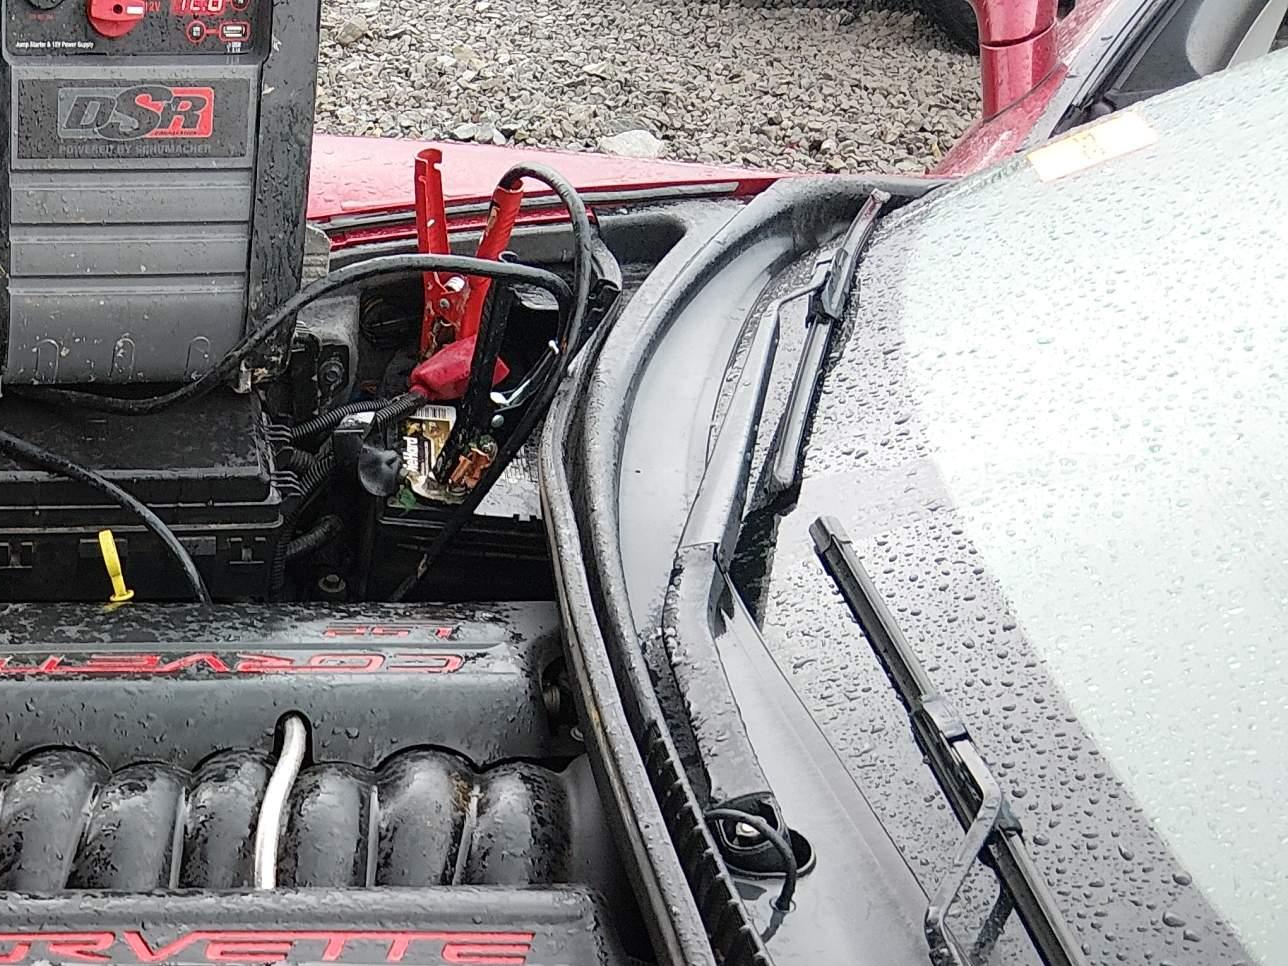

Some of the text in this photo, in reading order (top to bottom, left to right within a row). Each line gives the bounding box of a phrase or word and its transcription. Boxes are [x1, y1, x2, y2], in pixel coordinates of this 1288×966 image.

[77, 41, 94, 49] Supply
[62, 84, 209, 141] DSR
[136, 144, 212, 154] SCHUMACHER
[402, 436, 419, 472] ieHard
